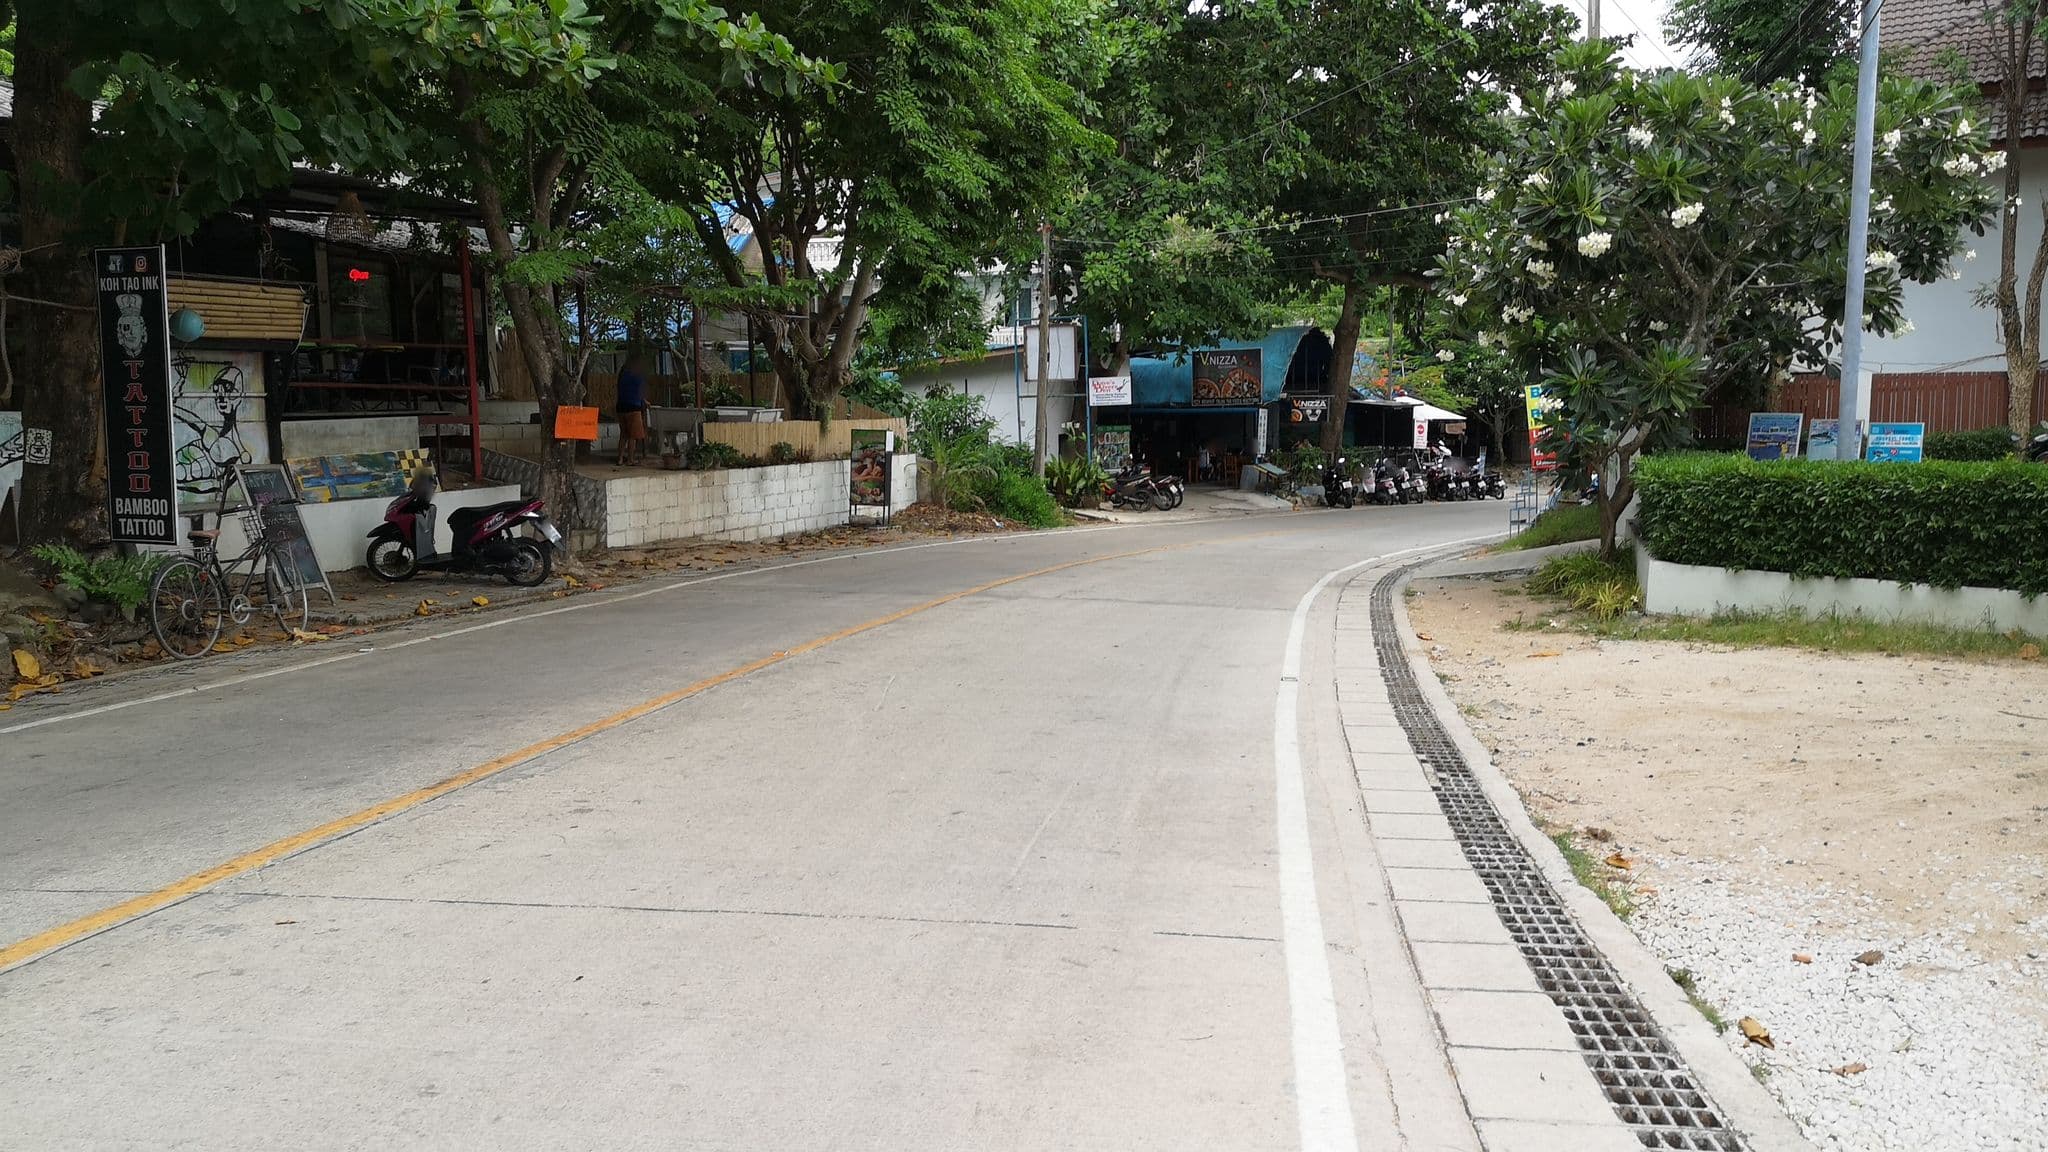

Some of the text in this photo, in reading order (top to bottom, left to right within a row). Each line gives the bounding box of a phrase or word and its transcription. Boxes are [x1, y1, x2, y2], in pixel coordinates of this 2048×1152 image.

[100, 275, 160, 294] KOH TAO INK
[122, 359, 151, 493] TATTOO
[115, 497, 169, 516] BAMBOO
[118, 517, 166, 537] TATTOO
